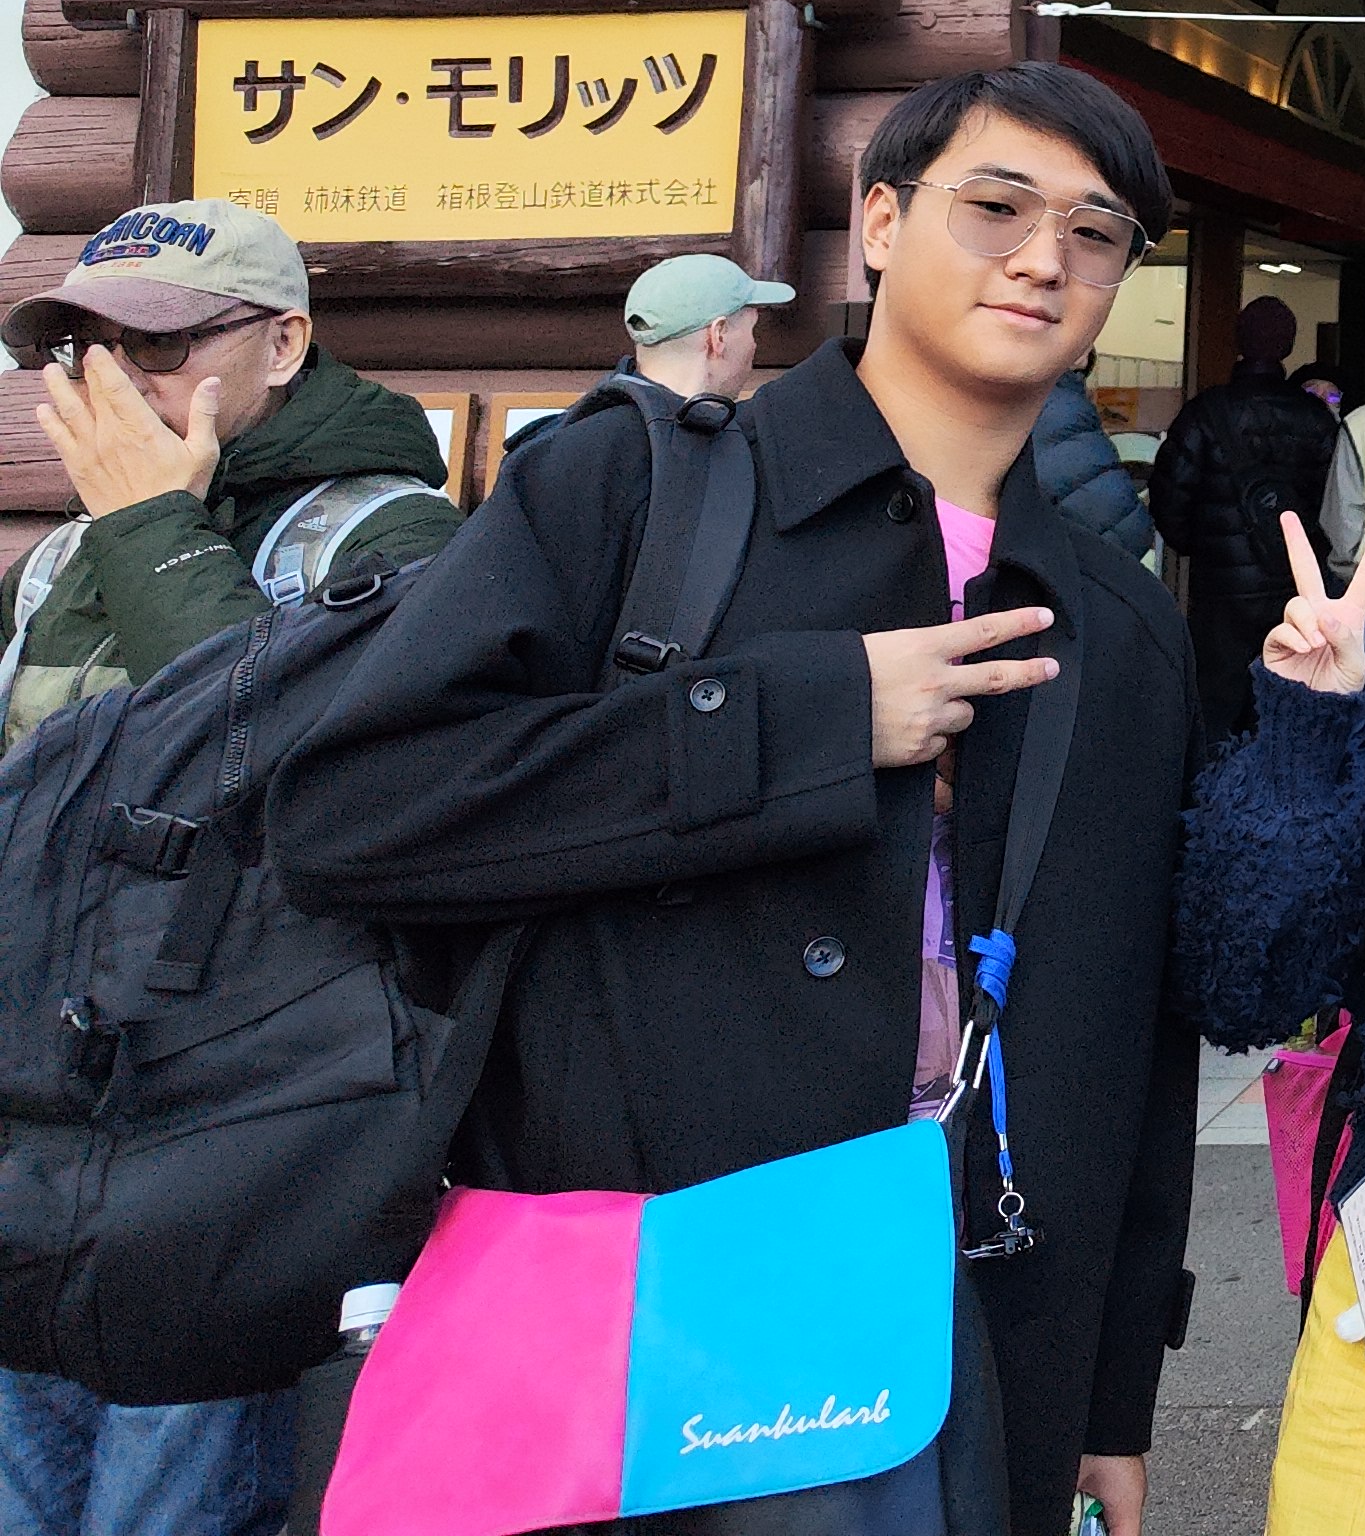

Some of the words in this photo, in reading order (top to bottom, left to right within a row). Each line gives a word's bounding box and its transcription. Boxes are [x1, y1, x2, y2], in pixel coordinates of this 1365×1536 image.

[233, 52, 718, 145] サン・モリッツ
[228, 187, 280, 216] 寄贈
[303, 183, 408, 213] 姉妹鉄道
[437, 177, 719, 211] 箱根登山鉄道株式会社
[679, 1388, 891, 1455] Suankularb
